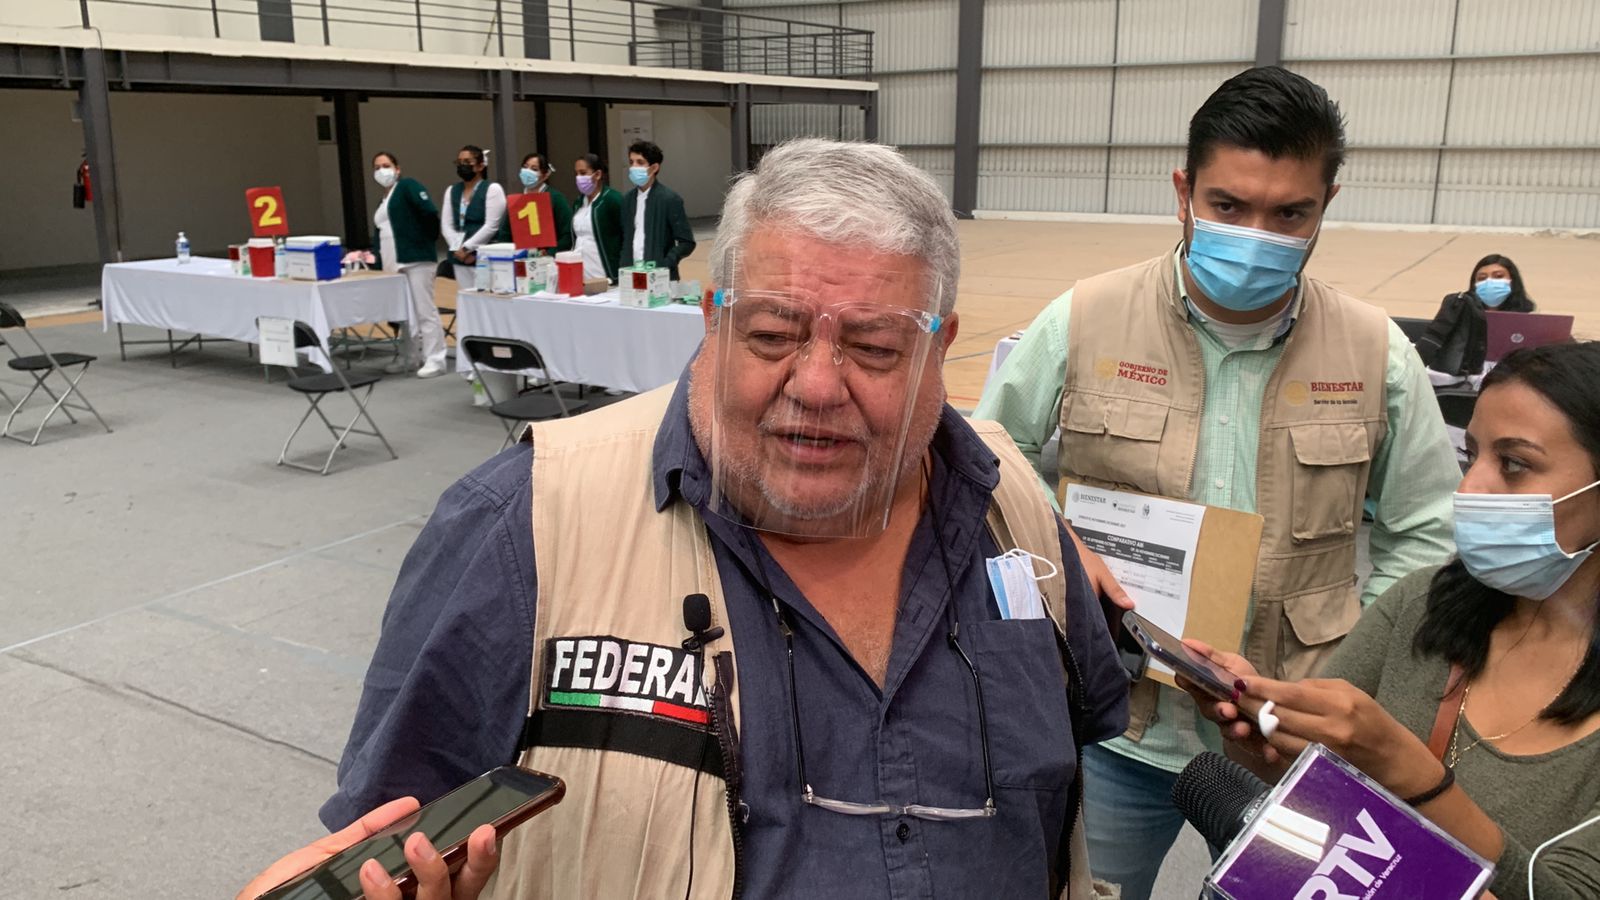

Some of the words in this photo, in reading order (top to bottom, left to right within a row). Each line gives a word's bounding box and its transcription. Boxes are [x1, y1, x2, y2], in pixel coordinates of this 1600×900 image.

[254, 195, 282, 227] 2
[518, 201, 541, 236] 1
[1117, 368, 1167, 386] MÉXICO
[1119, 361, 1156, 374] GOBIERNO
[1158, 368, 1168, 376] DE
[1311, 382, 1364, 392] BIENESTAR
[1293, 808, 1396, 900] RTV
[1374, 879, 1383, 888] de
[1379, 854, 1402, 879] Veracruz
